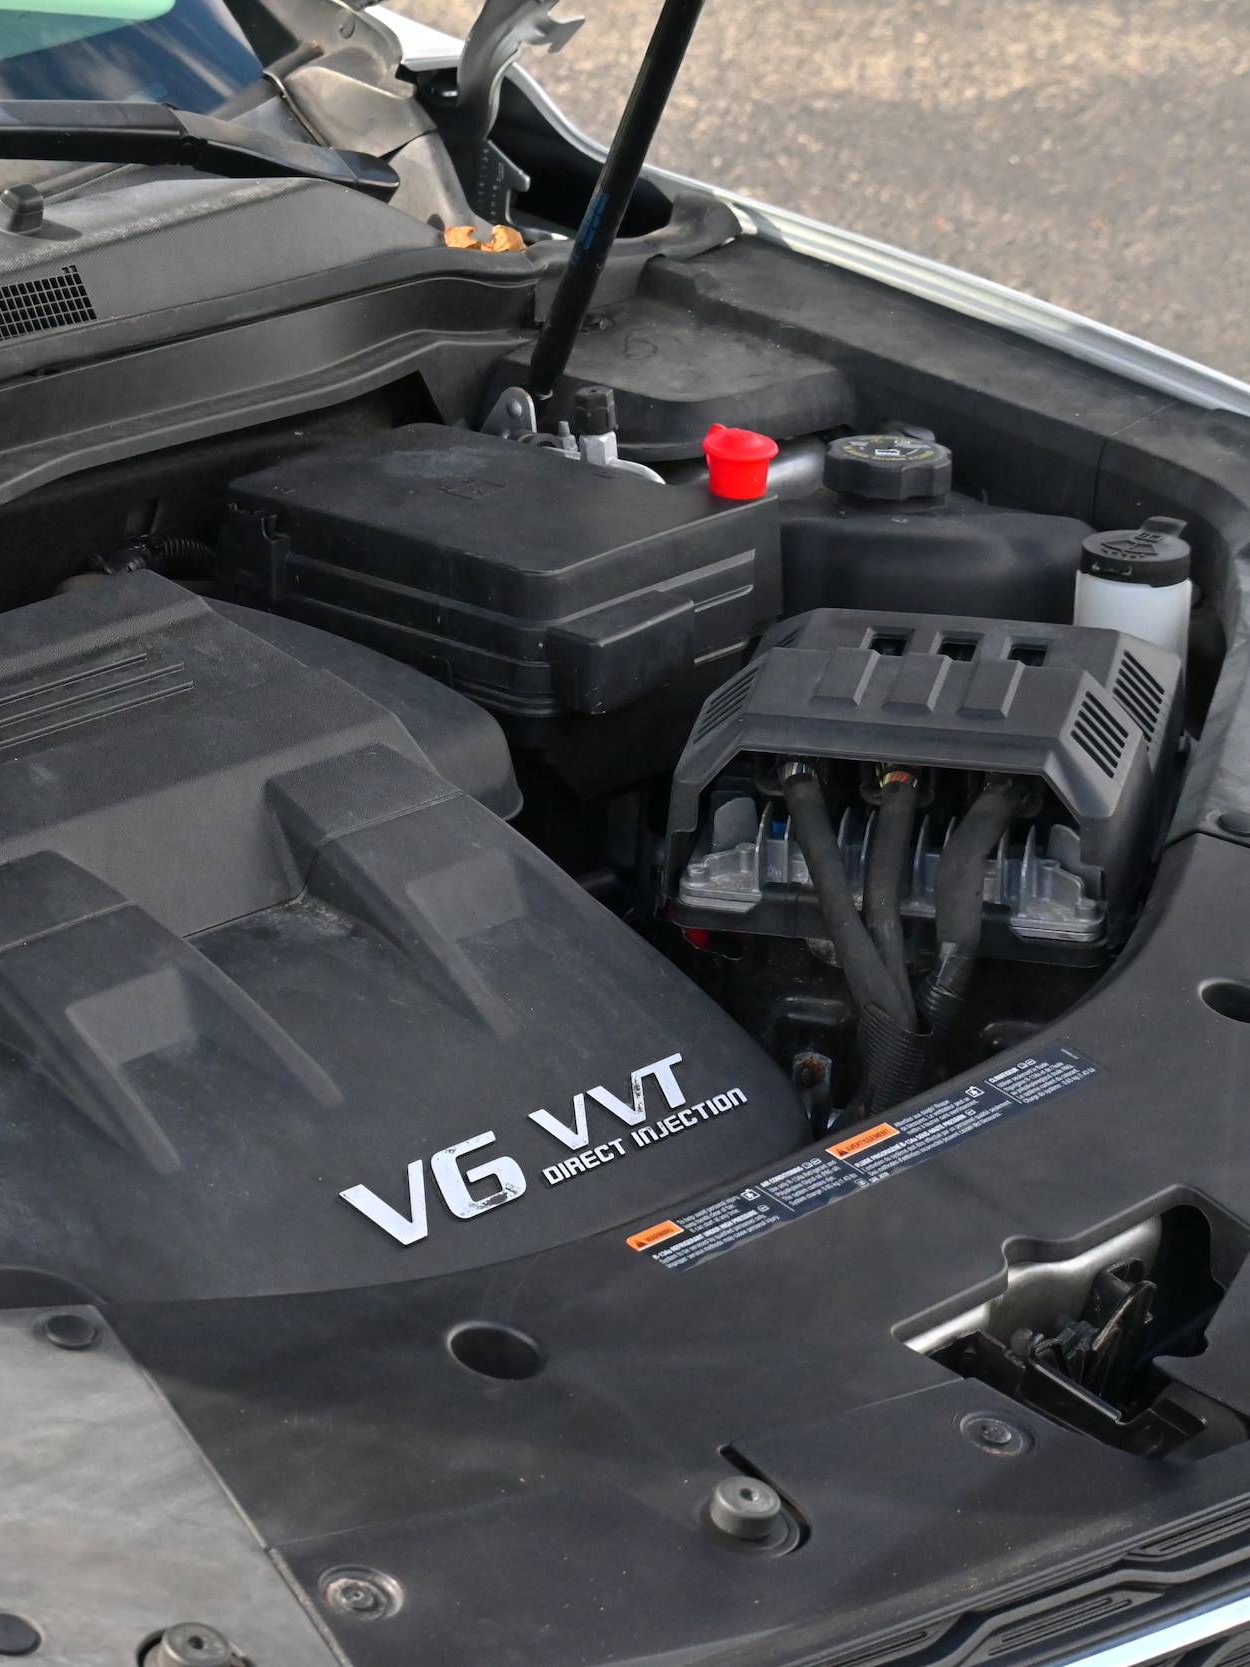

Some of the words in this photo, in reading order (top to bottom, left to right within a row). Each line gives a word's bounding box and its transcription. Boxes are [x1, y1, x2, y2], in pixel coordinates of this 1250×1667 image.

[541, 1138, 626, 1187] DIRECT
[631, 1087, 748, 1148] INJECTION
[845, 1129, 889, 1152] AVERTISSEMENT
[338, 1130, 528, 1247] V6
[527, 1053, 687, 1151] VVT
[769, 1166, 803, 1183] CONDITIONING
[646, 1226, 674, 1242] WARNING
